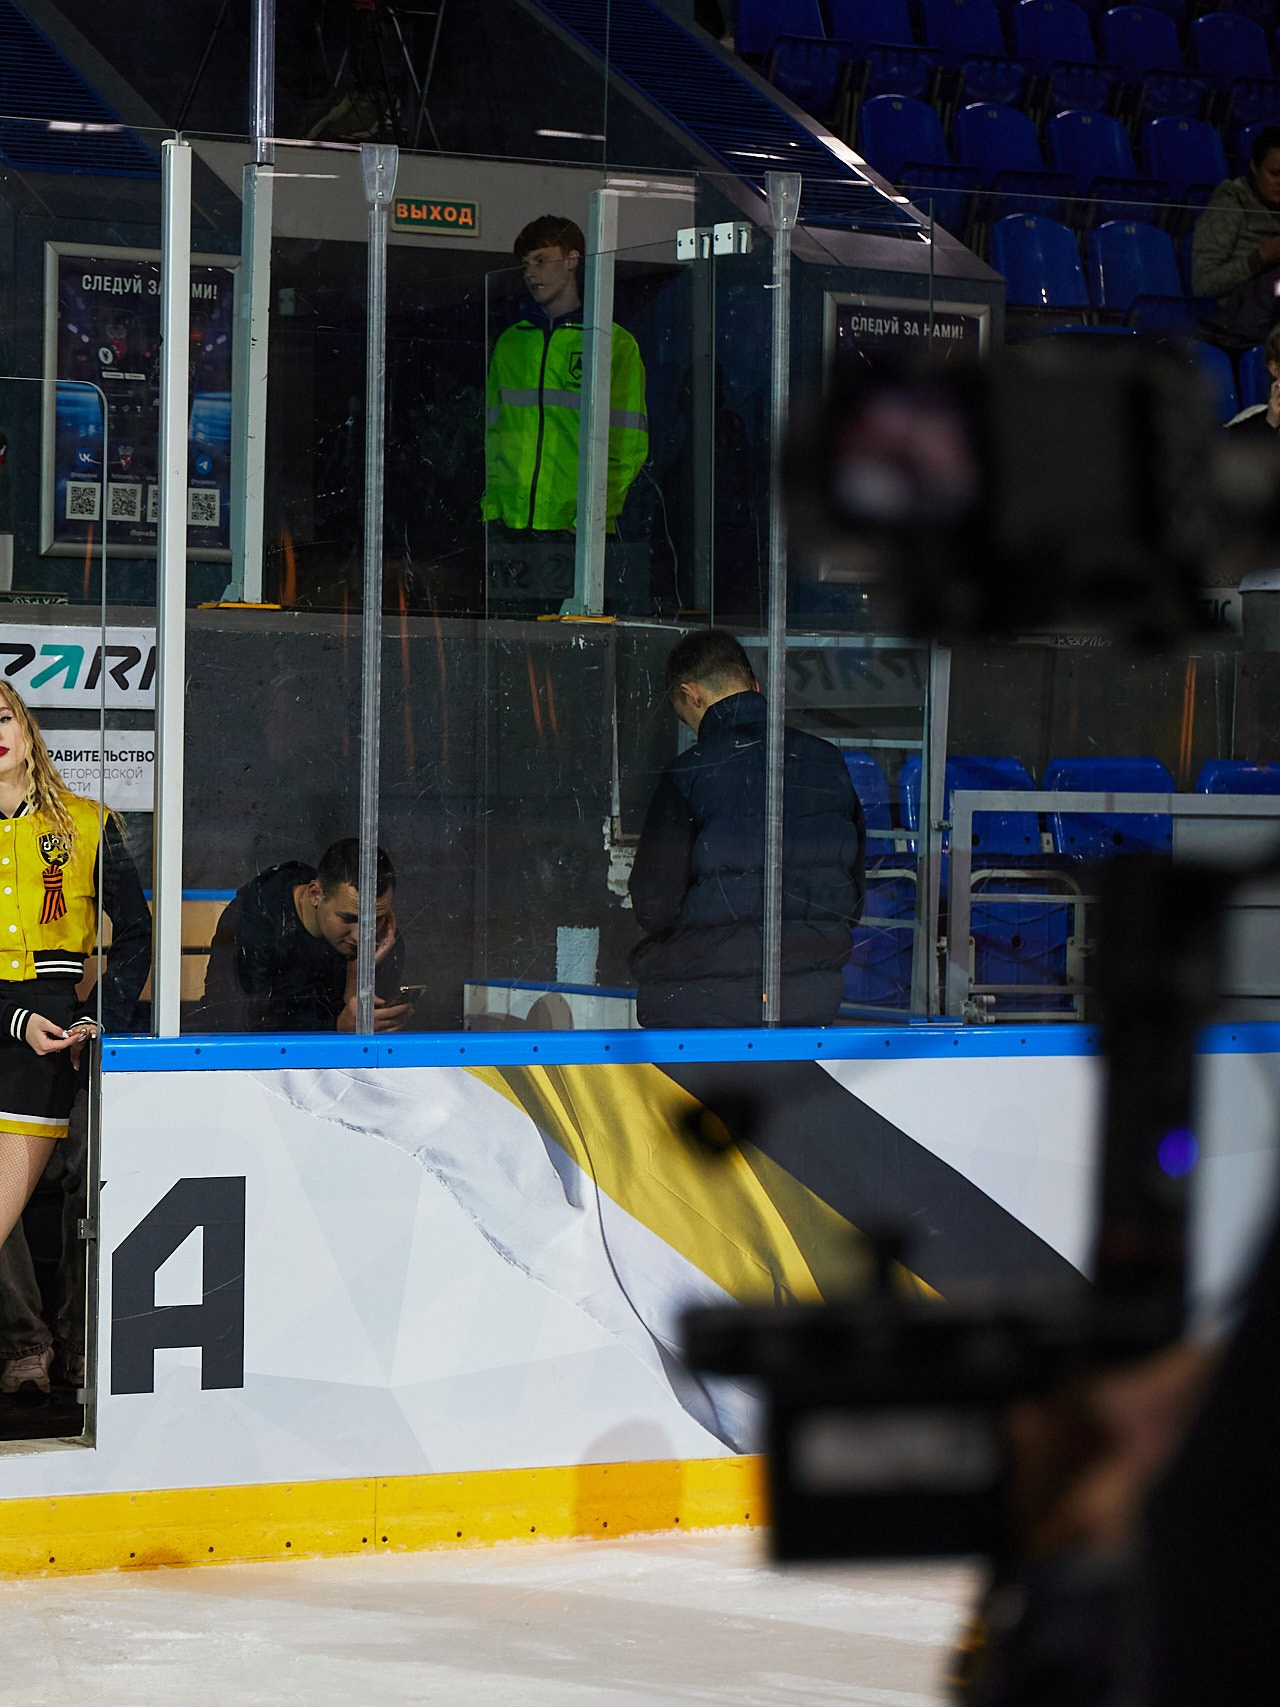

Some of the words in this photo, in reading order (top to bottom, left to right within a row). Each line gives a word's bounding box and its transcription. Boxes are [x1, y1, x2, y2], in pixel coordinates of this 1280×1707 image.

[396, 203, 473, 226] ВЫХОД
[82, 274, 142, 294] СЛЕДУЙ
[851, 316, 899, 336] СЛЕДУЙ
[904, 321, 919, 336] ЗА
[47, 750, 155, 763] РАВИТЕЛЬСТВО
[58, 766, 144, 780] ЕГОРОДСКОЙ
